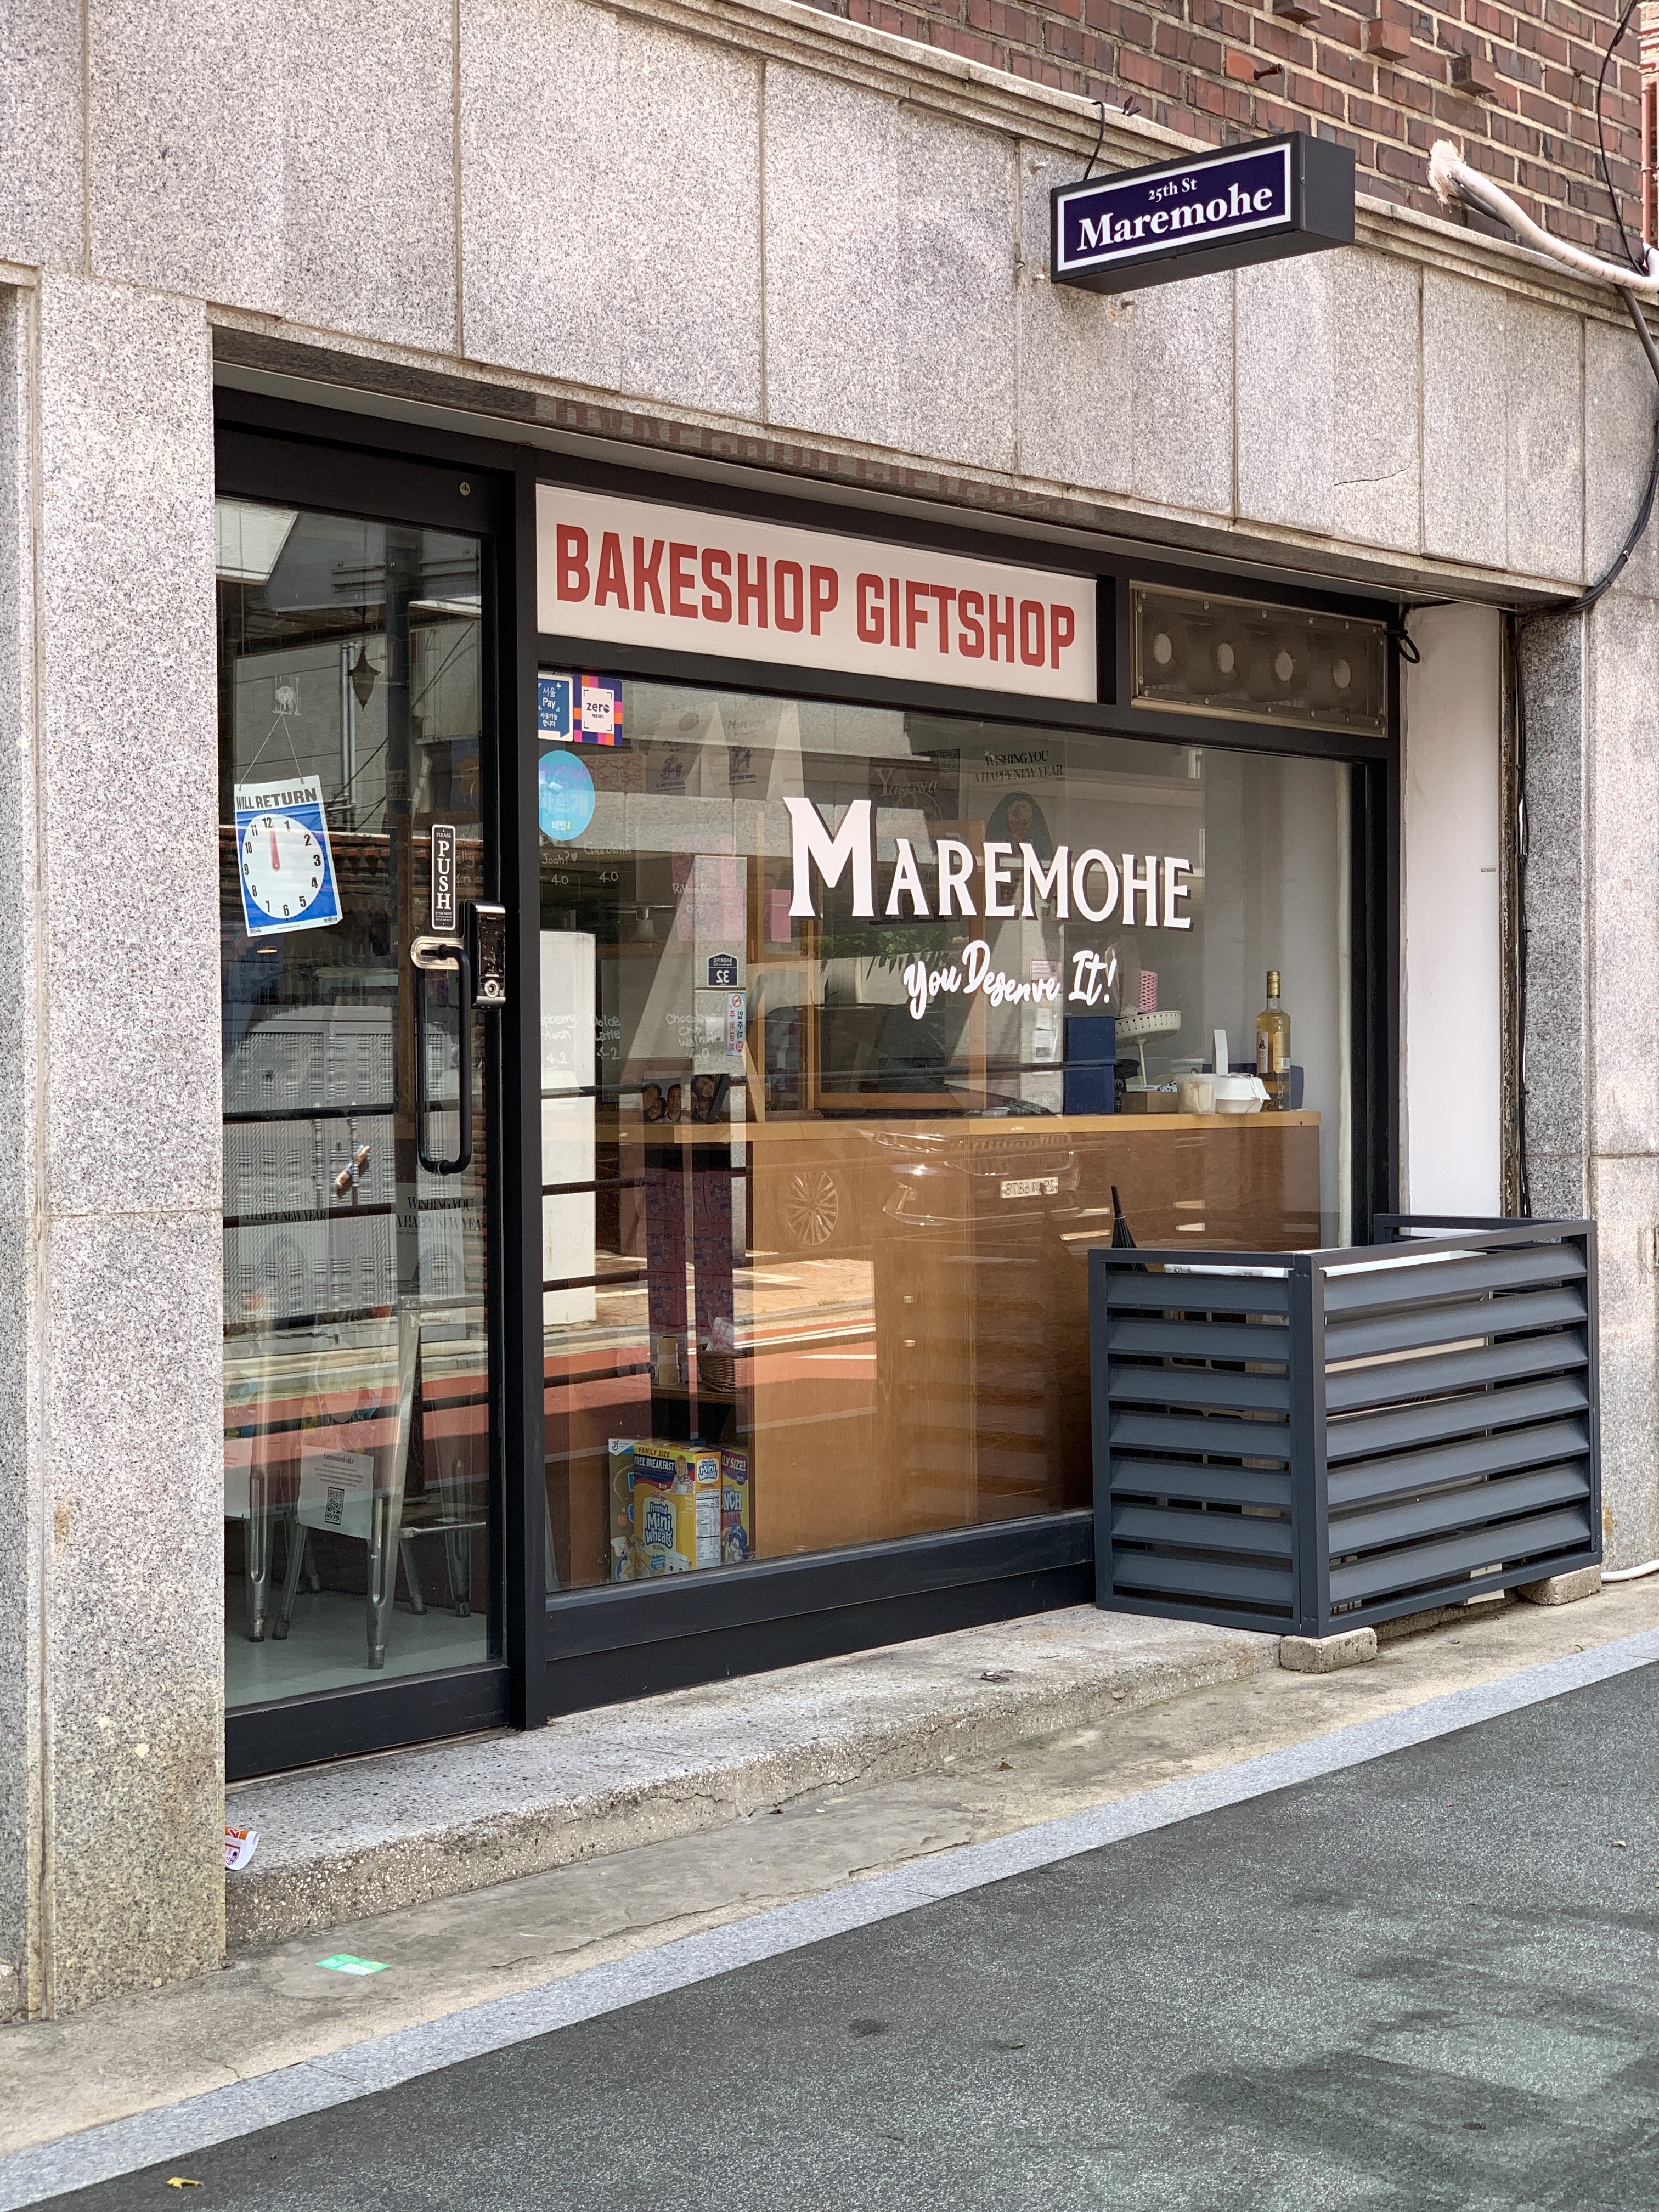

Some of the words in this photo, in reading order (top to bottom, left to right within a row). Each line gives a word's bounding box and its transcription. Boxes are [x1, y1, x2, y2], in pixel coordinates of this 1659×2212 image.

[1148, 180, 1178, 203] 25th
[1181, 177, 1197, 194] St
[1076, 182, 1272, 252] Maremohe
[555, 523, 839, 636] BAKESHOP
[856, 572, 1075, 670] GIFTSHOP
[543, 687, 556, 698] 서울
[543, 697, 556, 709] Pay
[540, 712, 558, 720] 사용가능
[1027, 751, 1048, 763] YOU
[1012, 767, 1036, 780] NEW
[1038, 765, 1064, 778] YEAR
[236, 796, 255, 810] WILL
[255, 788, 317, 808] RETURN
[262, 817, 272, 829] 12
[284, 820, 290, 832] 1
[251, 824, 258, 836] 11
[304, 834, 312, 847] 2
[245, 842, 252, 854] 10
[313, 855, 321, 866] 3
[783, 797, 1192, 930] MAREMOHE
[244, 863, 249, 875] 9
[436, 840, 452, 910] PUSH
[312, 877, 318, 889] 4
[599, 871, 619, 883] 4.0
[251, 885, 257, 897] 8
[266, 900, 270, 912] 7
[299, 896, 307, 908] 5
[283, 904, 290, 916] 6
[962, 940, 1060, 1007] Deserve
[1068, 949, 1117, 1006] It!
[408, 1197, 450, 1210] WISHING
[451, 1198, 474, 1212] YOU
[280, 1210, 301, 1221] NEW
[303, 1209, 326, 1221] YEAR
[638, 1447, 657, 1456] FAMILY
[658, 1450, 670, 1458] SIZE
[634, 1456, 646, 1467] FREE
[646, 1458, 675, 1471] BREAKFAST
[701, 1465, 716, 1474] Mini
[730, 1457, 746, 1472] SIZE!
[650, 1502, 668, 1514] Frosted
[647, 1513, 672, 1532] Mini
[645, 1528, 673, 1547] Wheats
